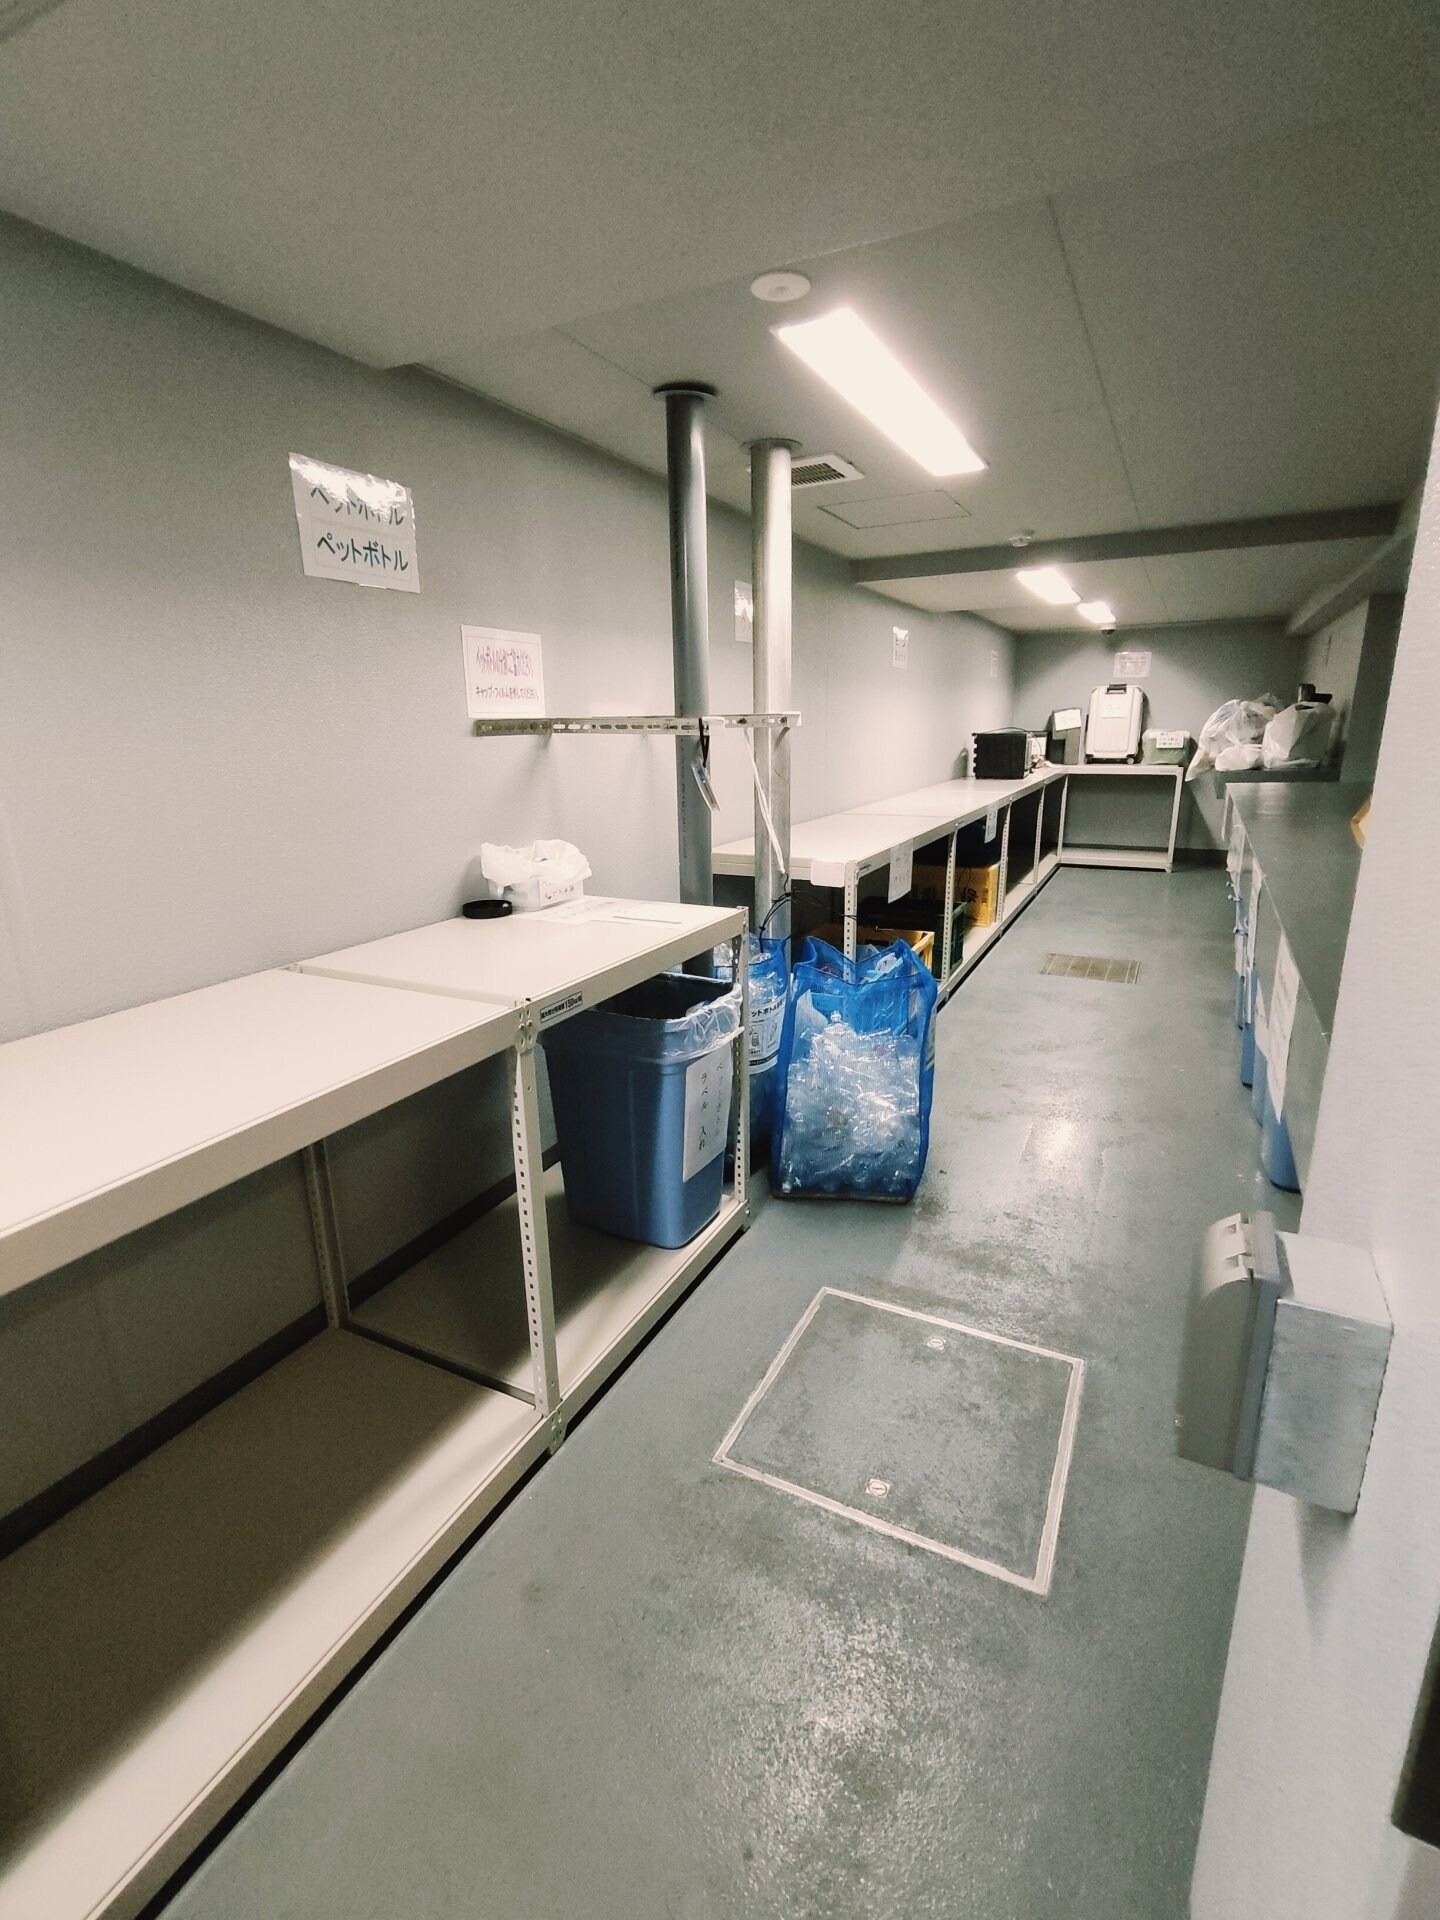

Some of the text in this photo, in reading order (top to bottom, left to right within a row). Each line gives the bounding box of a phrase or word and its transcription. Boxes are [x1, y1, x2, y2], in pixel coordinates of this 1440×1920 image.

[316, 531, 409, 572] ペットボトル
